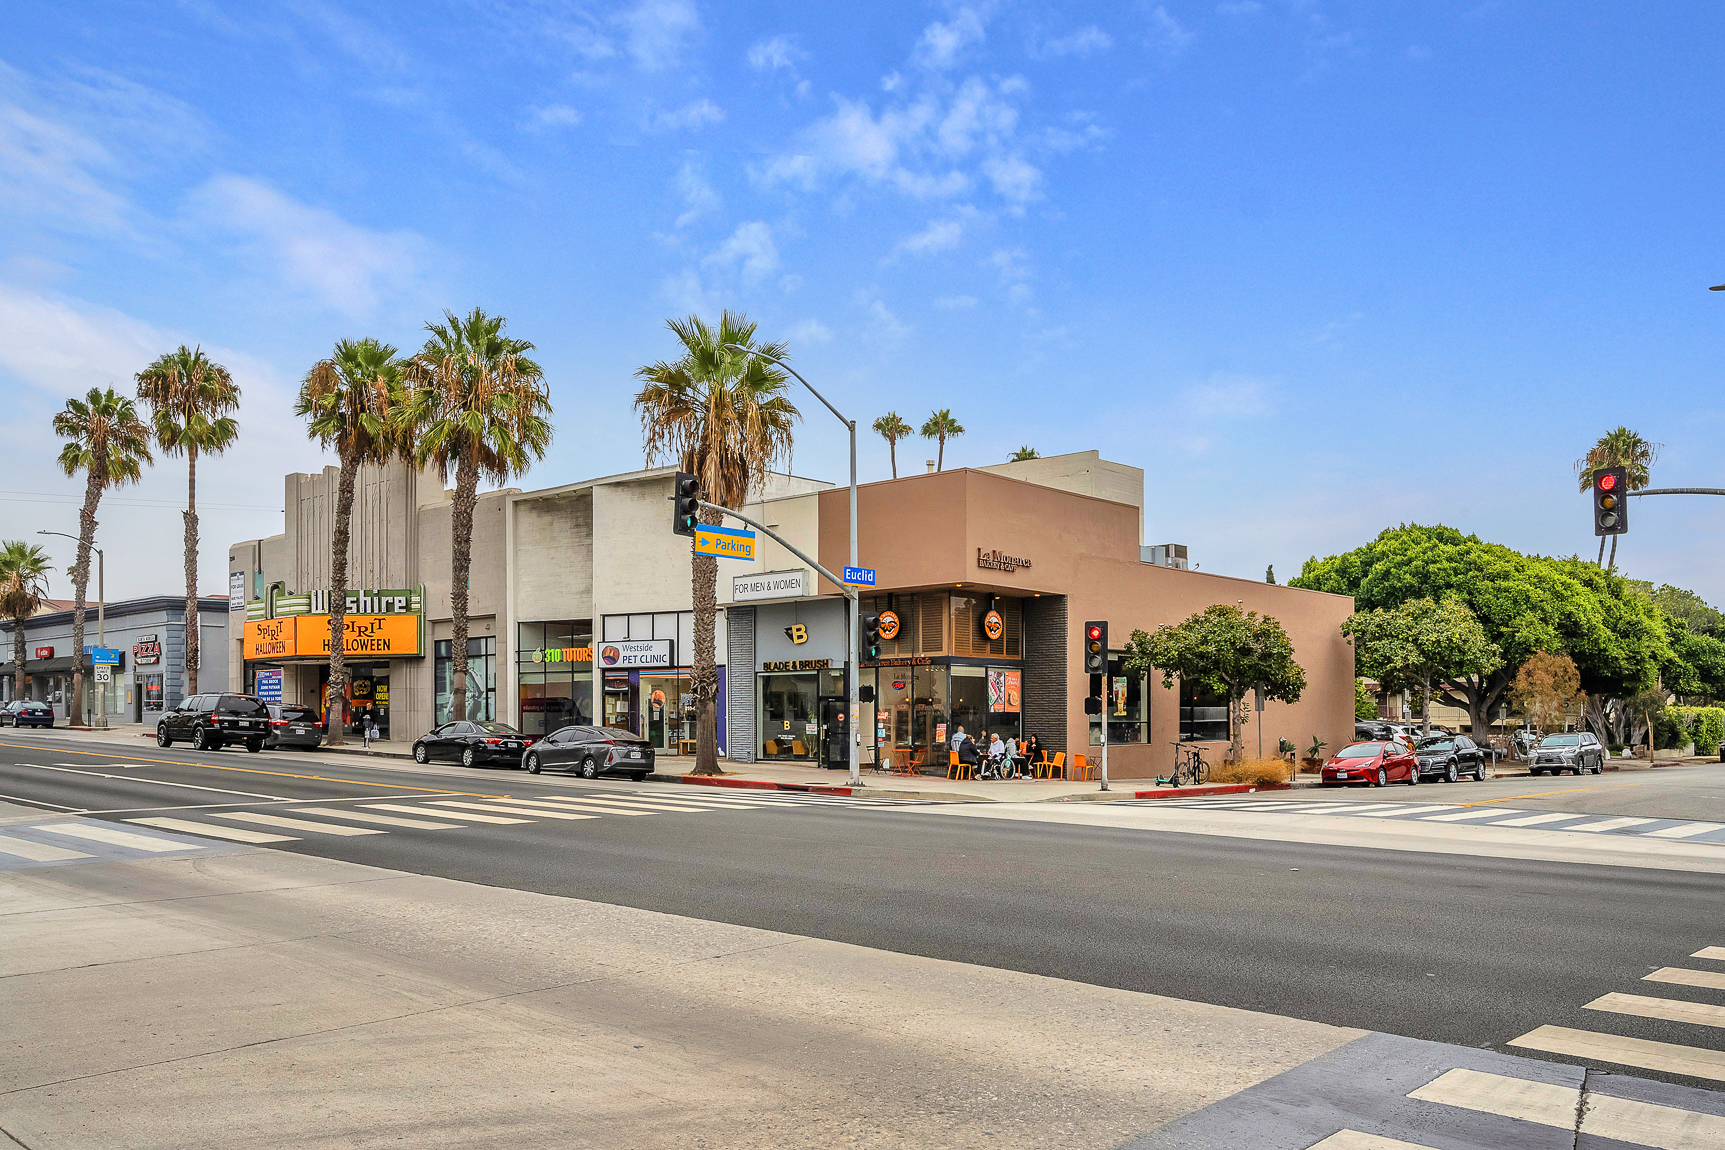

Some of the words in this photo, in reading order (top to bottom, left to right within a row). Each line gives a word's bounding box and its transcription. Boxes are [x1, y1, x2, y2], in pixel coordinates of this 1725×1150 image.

[716, 538, 751, 556] Parking
[978, 547, 990, 560] La
[993, 550, 1032, 567] Monarca
[846, 568, 873, 582] Euclid
[734, 583, 749, 594] FOR
[750, 581, 765, 592] MEN
[767, 581, 772, 591] &
[773, 578, 801, 590] WOMEN
[311, 589, 407, 614] Wshire
[257, 620, 284, 640] SPIRIT
[792, 623, 808, 644] B
[132, 642, 160, 656] PIZZA
[255, 640, 286, 655] HALLOWEEN
[323, 638, 391, 651] HLOWEEN
[621, 643, 654, 652] Westside
[544, 648, 561, 662] 310
[561, 647, 593, 662] TUTORS
[622, 655, 638, 664] PET
[640, 654, 667, 664] CLINIC
[763, 661, 790, 671] BLADE
[791, 660, 797, 670] &
[798, 659, 829, 669] BRUSH
